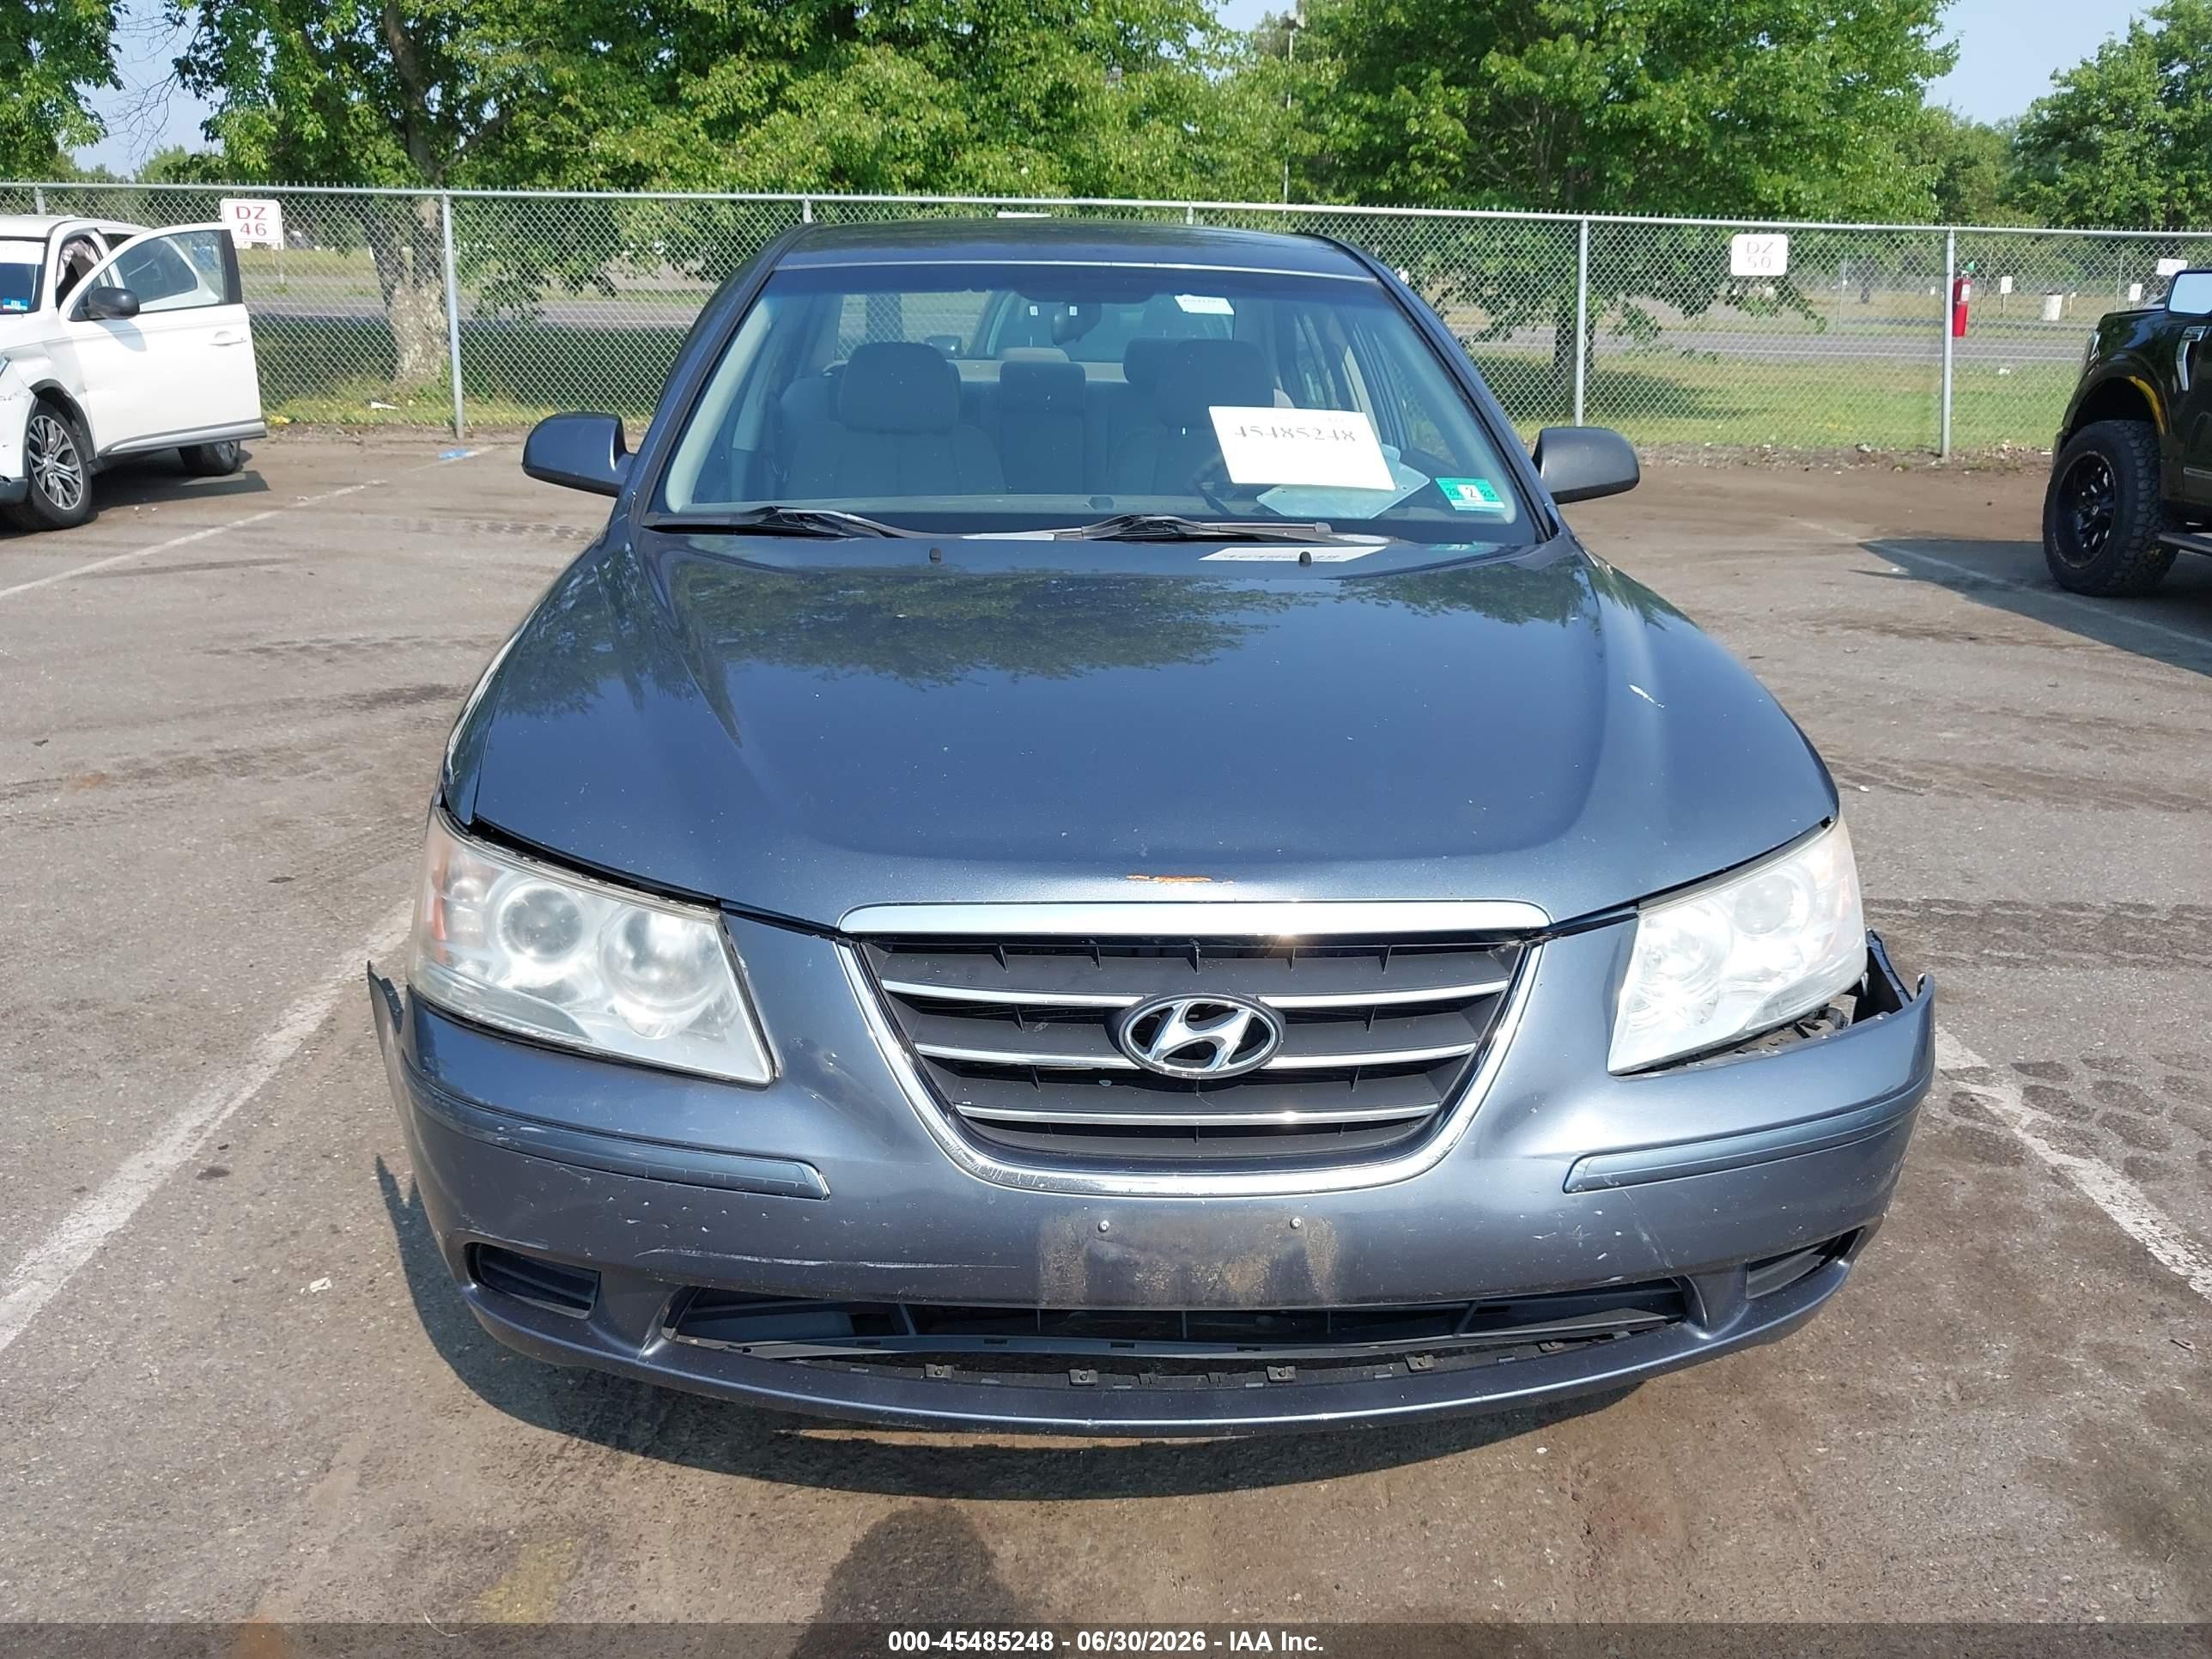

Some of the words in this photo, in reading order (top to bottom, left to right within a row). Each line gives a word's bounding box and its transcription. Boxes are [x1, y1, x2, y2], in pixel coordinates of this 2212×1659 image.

[235, 205, 268, 221] DZ
[240, 222, 267, 237] 46
[1746, 241, 1774, 255] DZ
